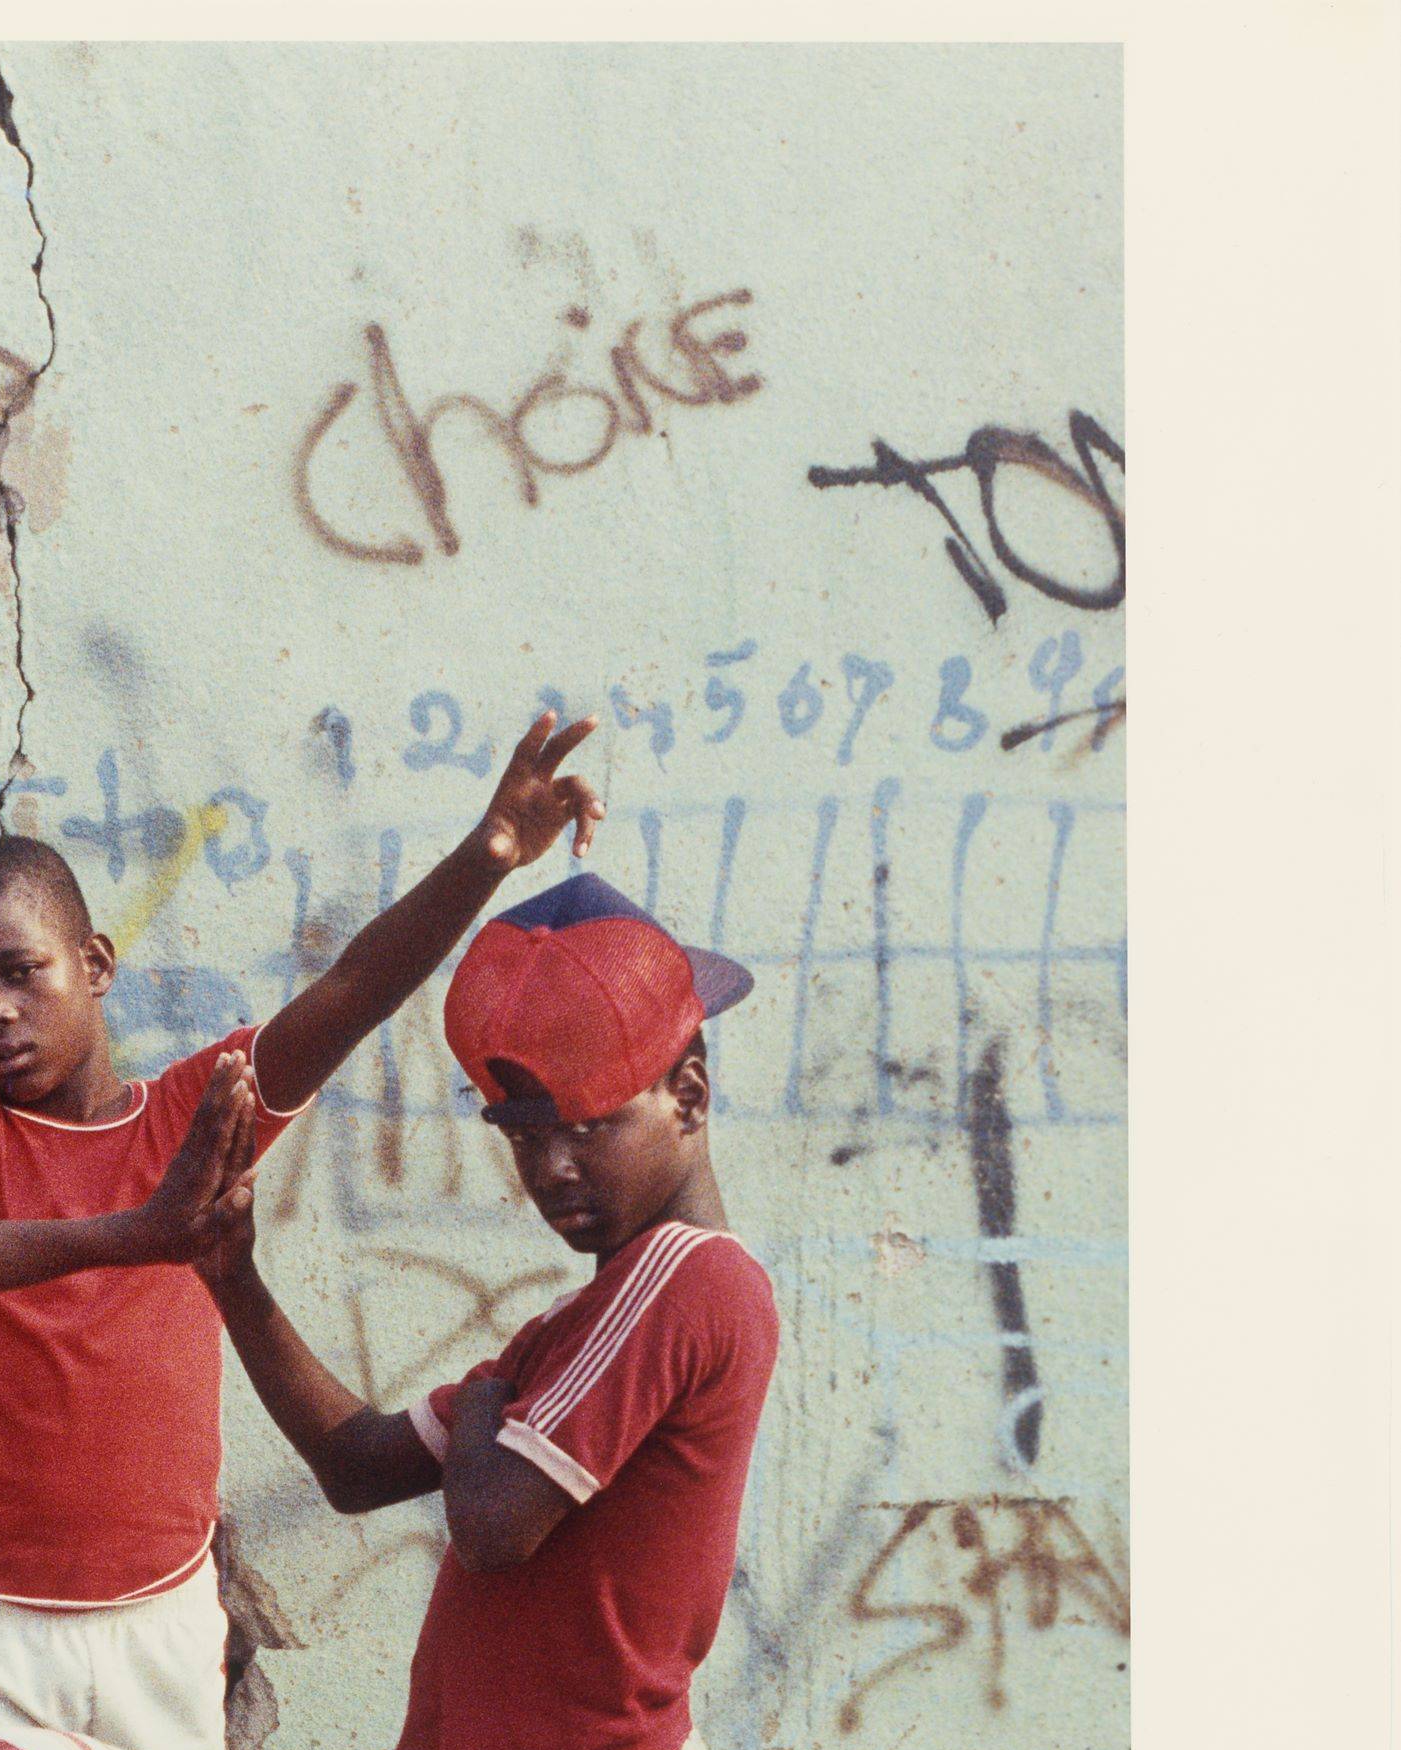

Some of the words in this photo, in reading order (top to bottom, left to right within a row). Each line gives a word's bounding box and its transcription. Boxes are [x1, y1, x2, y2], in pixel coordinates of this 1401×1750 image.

[403, 690, 491, 779] 2
[705, 637, 758, 743] 5
[778, 661, 825, 738] 6
[841, 653, 895, 767] 7
[930, 654, 990, 752] 8
[1027, 628, 1084, 753] 9
